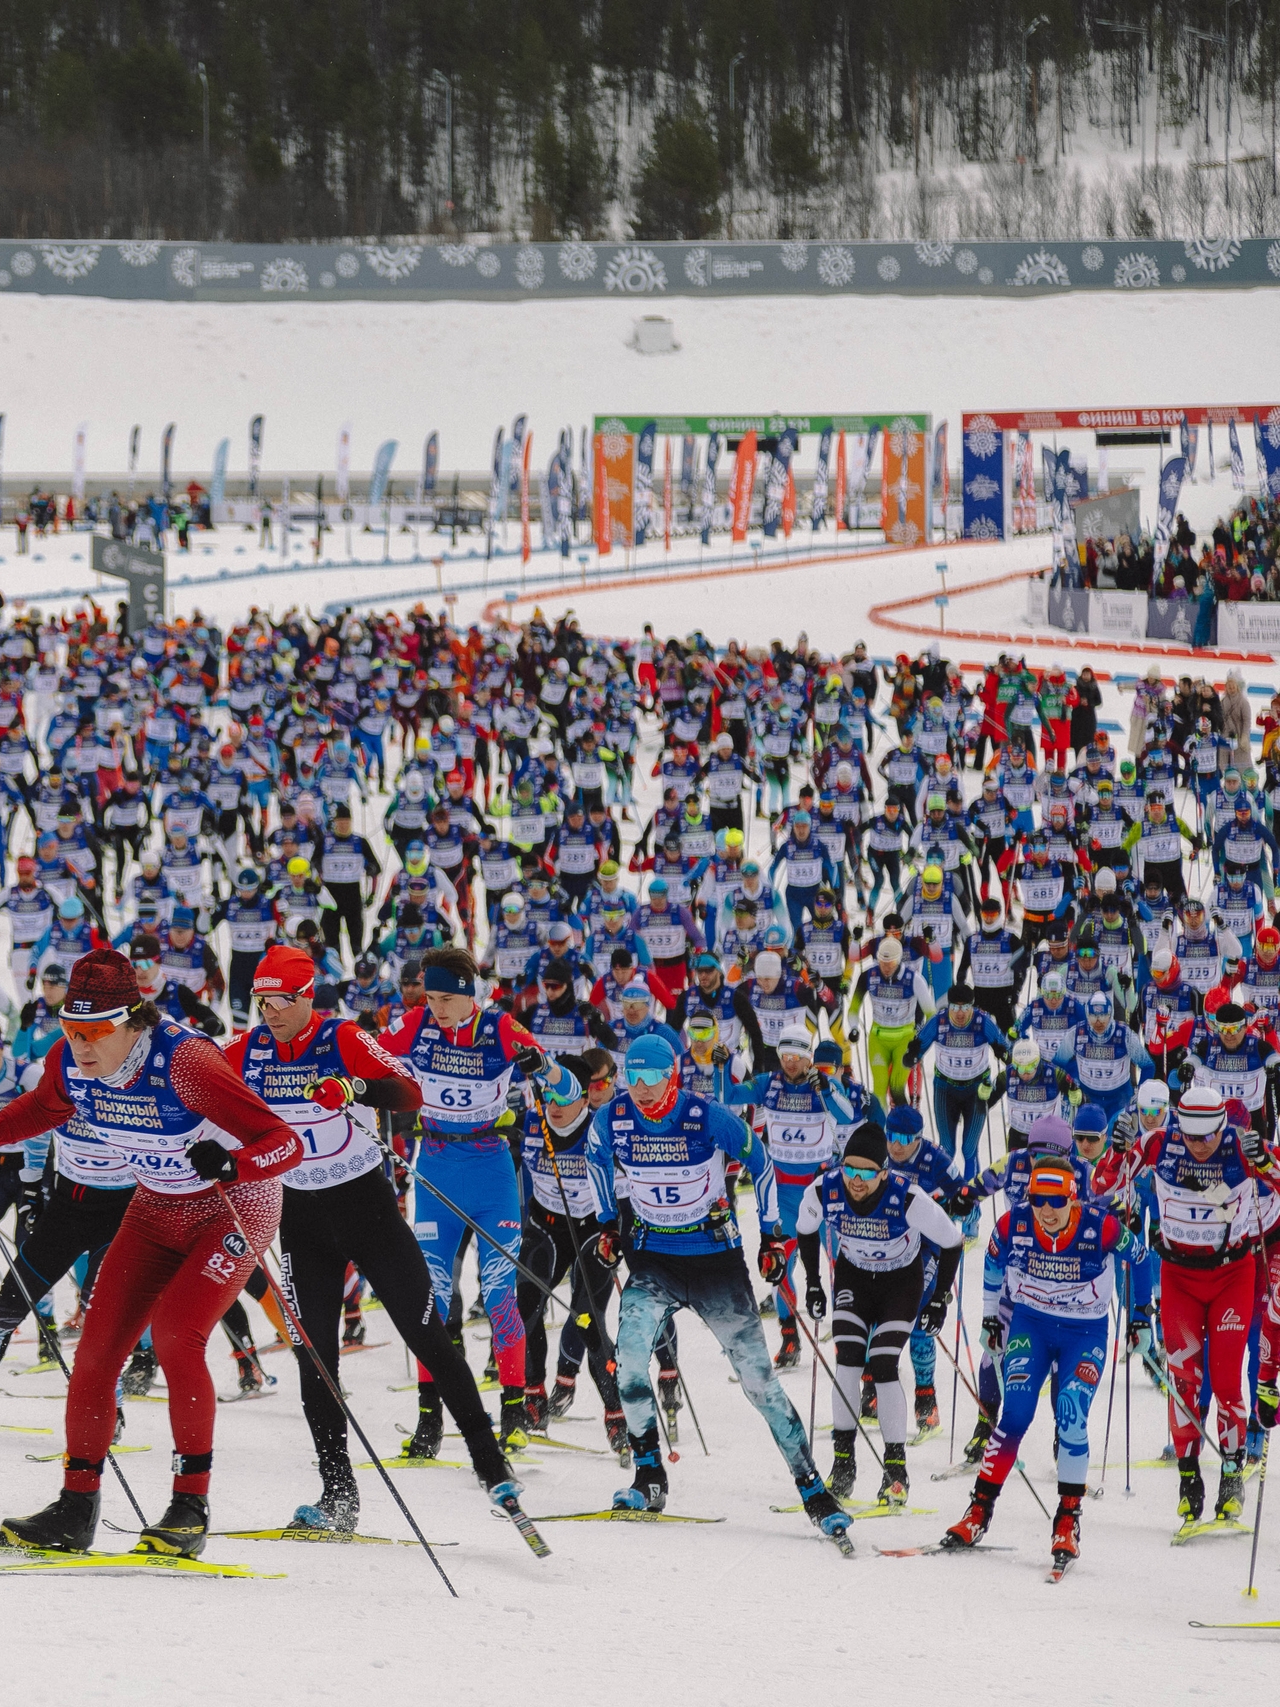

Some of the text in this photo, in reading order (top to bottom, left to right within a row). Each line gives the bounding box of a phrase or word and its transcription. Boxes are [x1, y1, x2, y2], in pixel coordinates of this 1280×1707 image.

[707, 417, 764, 432] ФИНИШ
[769, 417, 786, 432] 25
[1078, 412, 1137, 426] ФИНИШ
[1142, 410, 1160, 425] 50
[1163, 410, 1185, 424] КМ
[433, 1043, 449, 1054] 50-Й
[432, 1052, 484, 1067] ЛЫЖНЫЙ
[264, 1063, 318, 1073] 50-Й МУРМАНСКИЙ
[431, 1062, 484, 1076] МАРАФОН
[264, 1071, 318, 1086] ЛЫЖНЫЙ
[91, 1087, 157, 1103] 50-Й МУРМАНСКИЙ
[264, 1087, 304, 1098] МАРАФ
[440, 1088, 472, 1107] 63
[94, 1099, 160, 1118] ЛЫЖНЫЙ
[96, 1111, 164, 1130] МАРАФОН
[303, 1128, 318, 1154] 1
[649, 1135, 687, 1143] МУРМАНСКИЙ
[782, 1128, 807, 1142] 64
[632, 1141, 688, 1153] ЛЫЖНЫЙ
[632, 1153, 689, 1162] МАРАФОН
[168, 1166, 197, 1177] РОМА
[1178, 1165, 1224, 1178] ЛЫЖНЫЙ
[650, 1187, 681, 1204] 15
[1188, 1207, 1214, 1220] 17
[841, 1220, 889, 1233] ЛЫЖНЫЙ
[841, 1229, 890, 1239] МАРАФОН
[207, 1252, 236, 1279] 82
[1028, 1259, 1081, 1273] ЛЫЖНЫЙ
[1028, 1269, 1081, 1281] МАРАФОН
[610, 1511, 659, 1522] FISCHER
[280, 1530, 354, 1543] FISCHER
[145, 1556, 178, 1567] FISCHER
